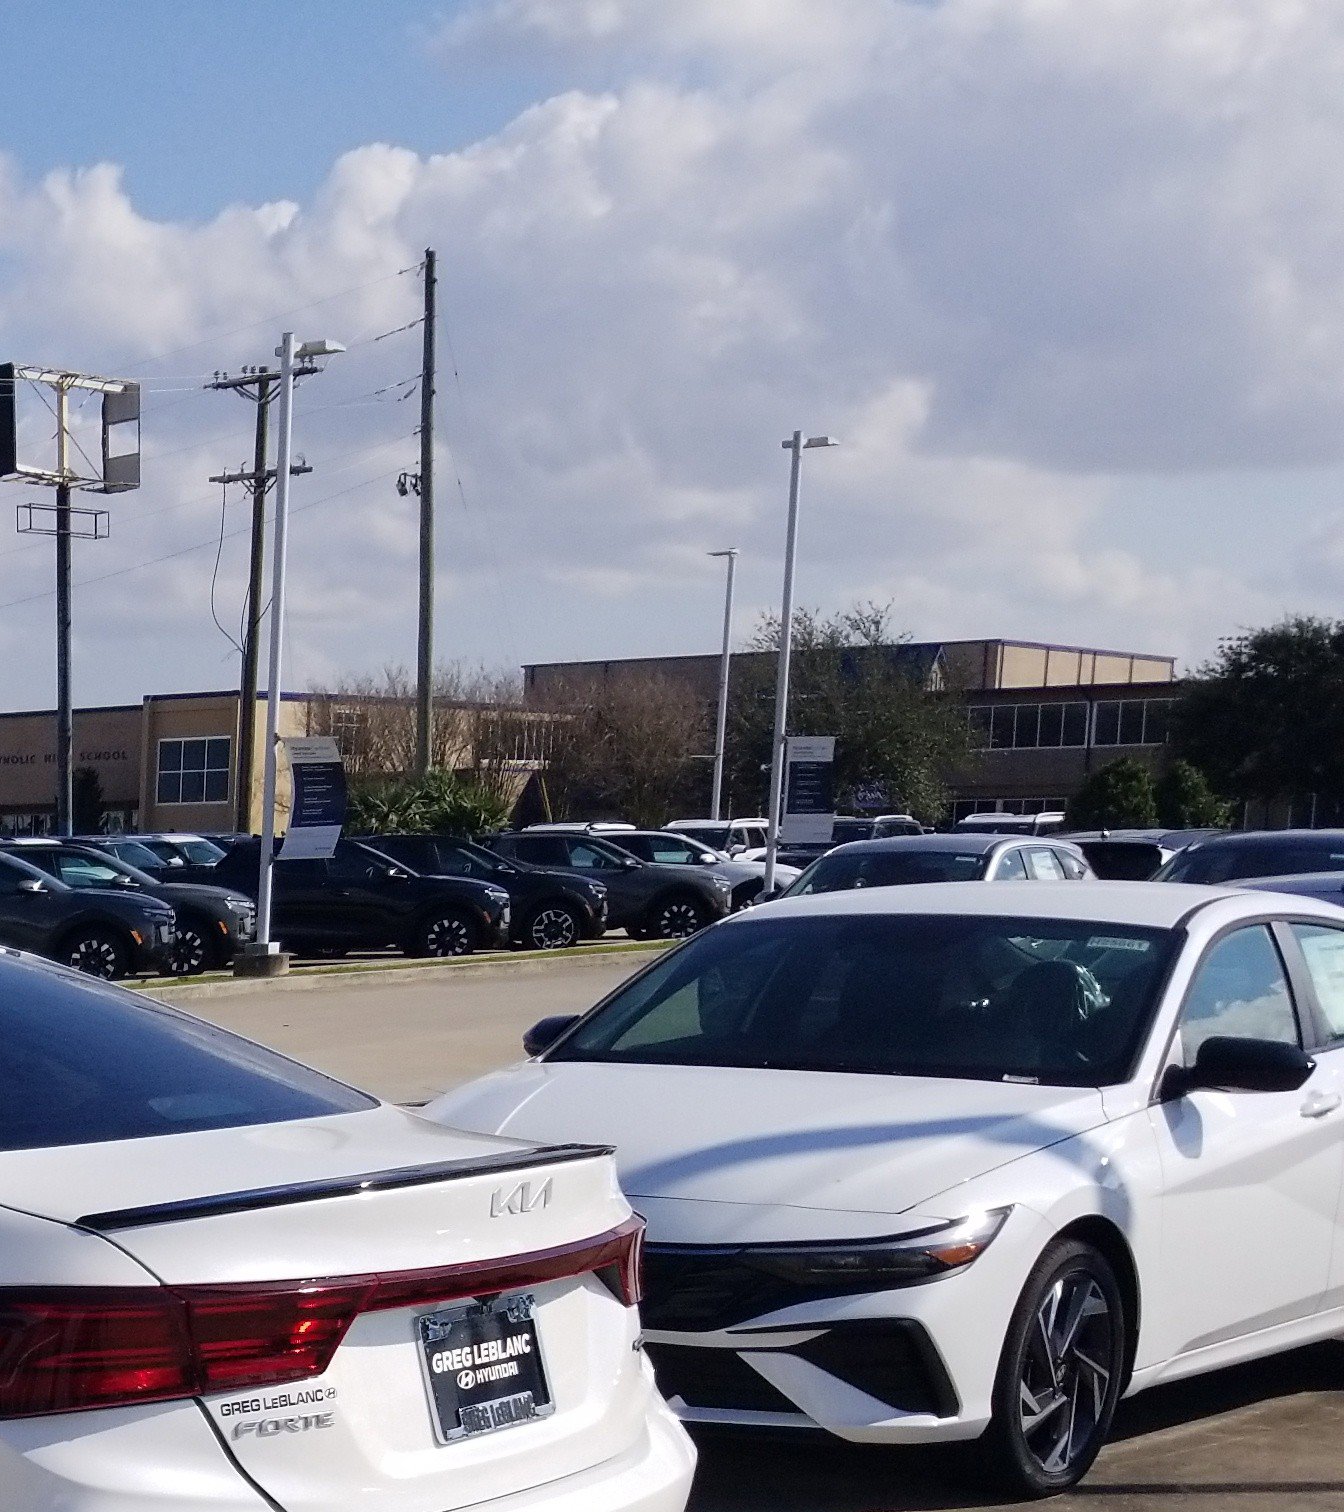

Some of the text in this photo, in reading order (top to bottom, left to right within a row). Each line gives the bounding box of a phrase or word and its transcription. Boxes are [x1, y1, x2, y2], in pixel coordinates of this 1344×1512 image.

[79, 750, 127, 762] SCHOOL
[490, 1177, 553, 1218] KIA
[432, 1333, 531, 1374] GREG LEBLANC
[476, 1361, 519, 1384] HYUNDAI
[220, 1399, 261, 1416] GREG
[231, 1411, 335, 1441] FORTE
